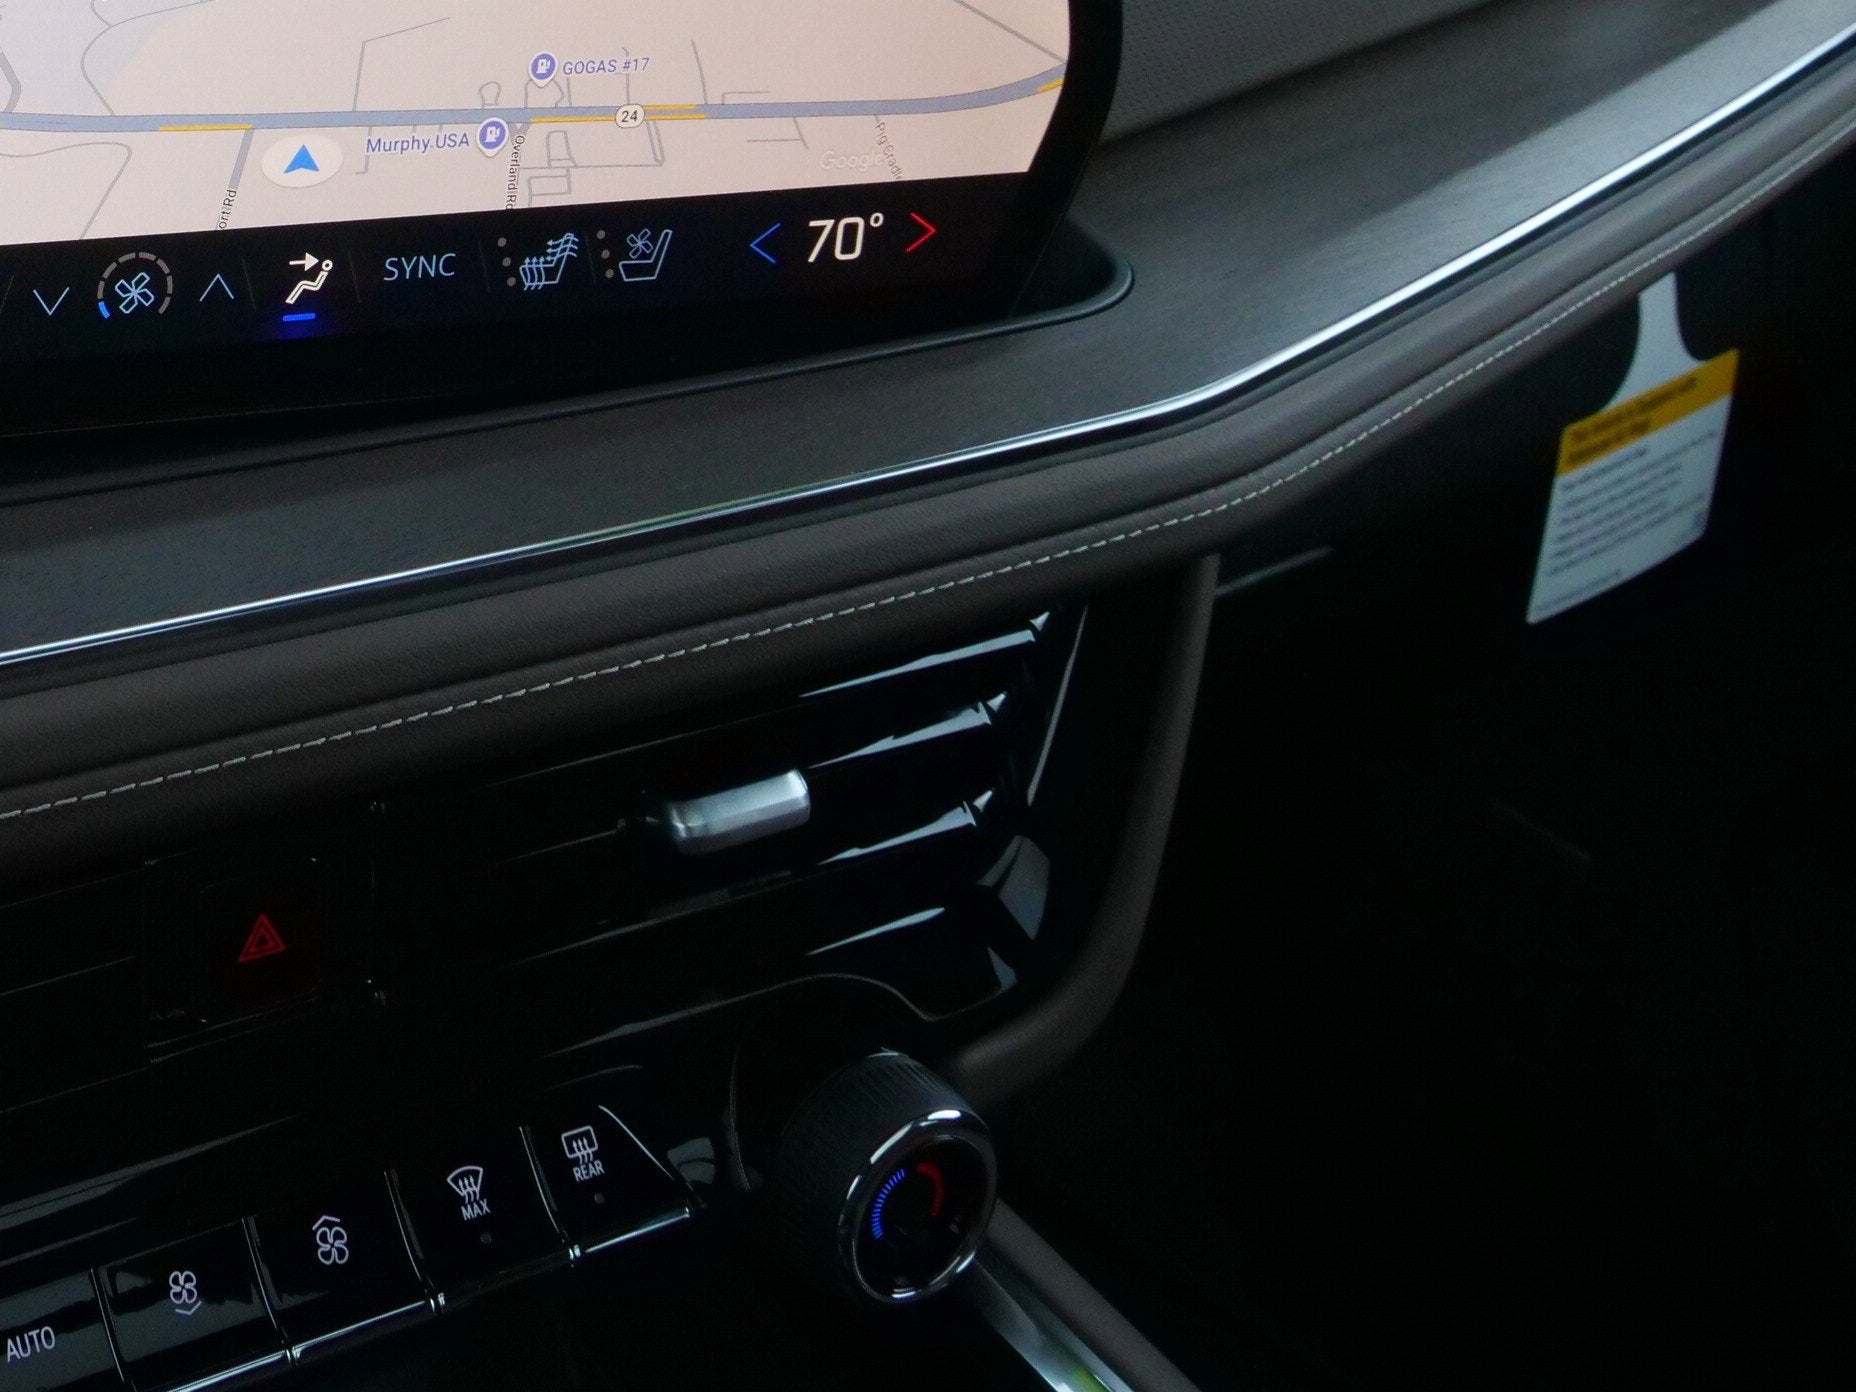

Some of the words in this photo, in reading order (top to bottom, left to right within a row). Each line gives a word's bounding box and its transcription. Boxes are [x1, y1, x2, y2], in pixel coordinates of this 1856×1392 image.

[562, 59, 618, 76] GOGAS
[622, 56, 650, 73] #17
[620, 110, 639, 123] 24
[365, 134, 431, 156] Murphy
[434, 132, 470, 149] USA
[875, 121, 889, 146] Pig
[506, 134, 526, 193] Overland
[222, 188, 238, 207] Rd
[383, 252, 457, 282] SYNC
[572, 1159, 606, 1182] REAR
[460, 1198, 491, 1221] MAX
[6, 1325, 56, 1364] AUTO
